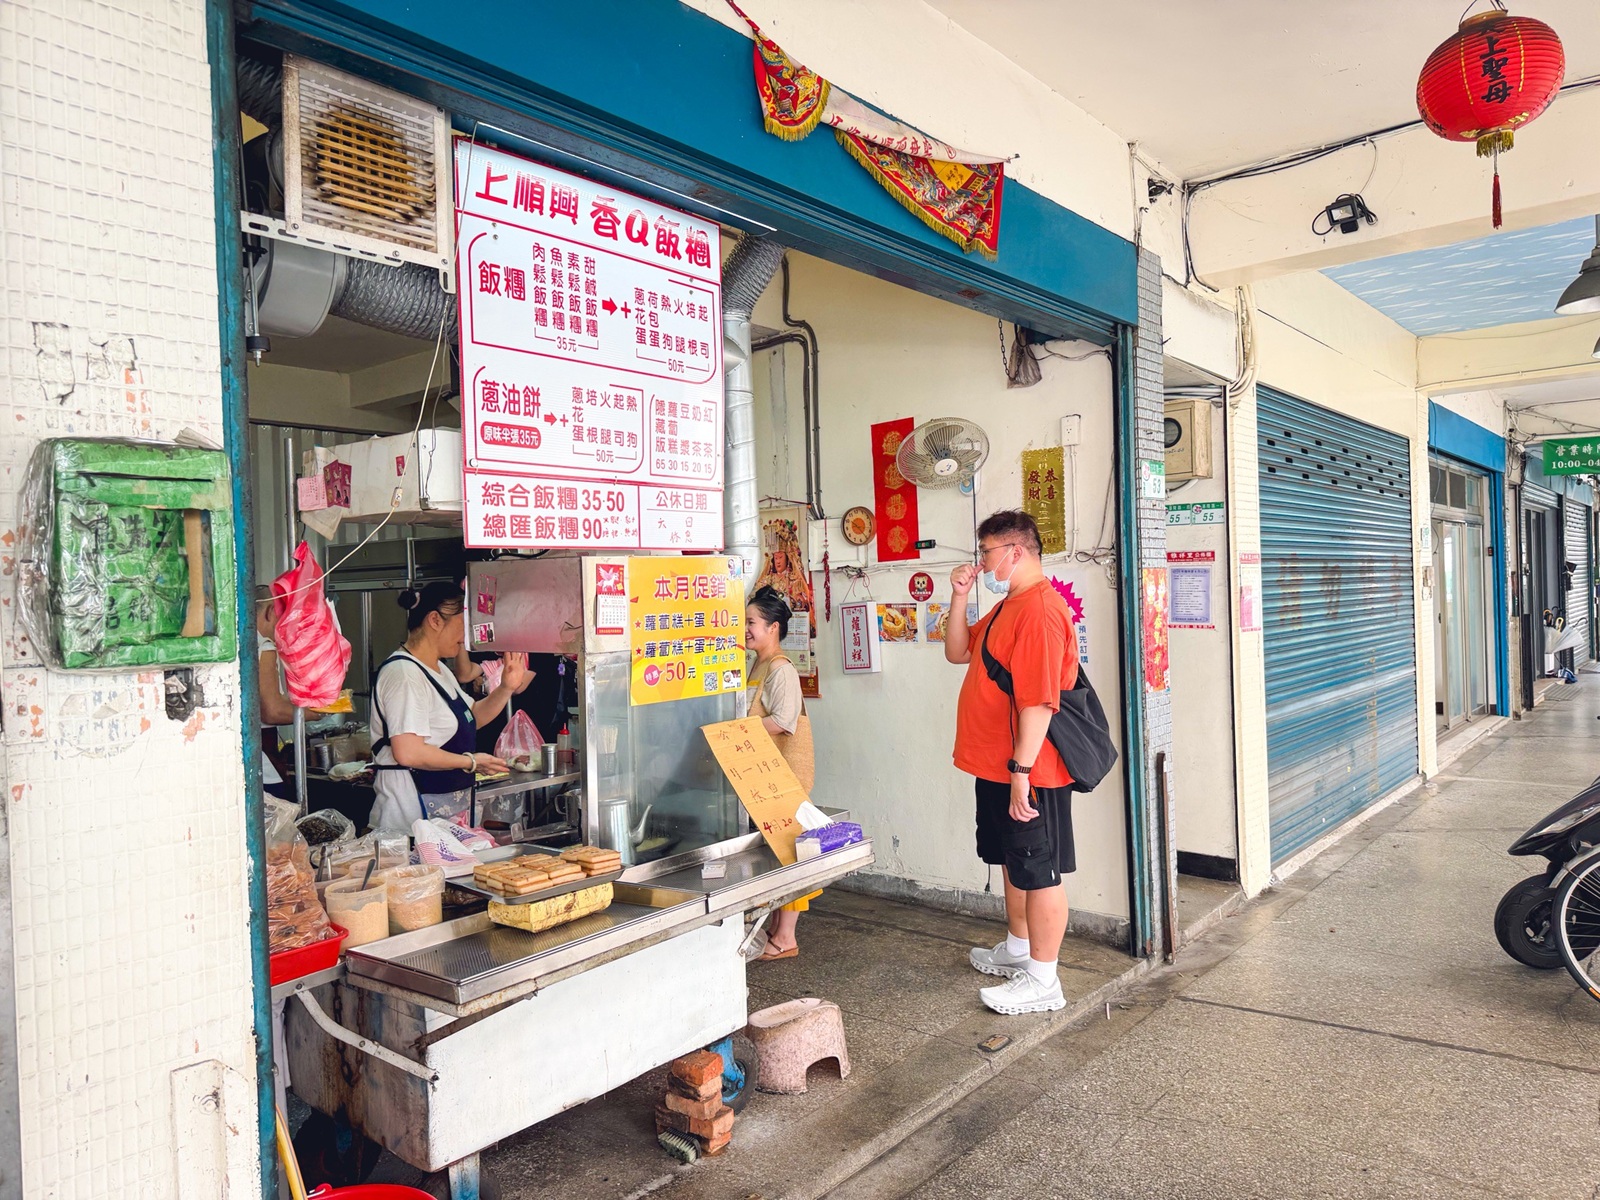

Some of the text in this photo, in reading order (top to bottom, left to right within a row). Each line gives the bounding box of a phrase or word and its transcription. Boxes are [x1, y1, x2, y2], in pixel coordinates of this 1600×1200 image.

[475, 161, 712, 269] 上順興 香Q飯糰
[478, 259, 526, 301] 飯糰
[532, 242, 548, 328] 肉鬆飯糰
[550, 247, 565, 331] 魚鬆飯糰
[567, 252, 582, 335] 素鬆飯糰
[584, 256, 598, 338] 甜鹹飯糰
[648, 291, 660, 349] 荷包蛋
[556, 335, 577, 353] 35元
[668, 358, 685, 374] 50元
[480, 379, 542, 419] 蔥油餅
[596, 449, 614, 464] 50元
[655, 458, 666, 470] 65
[668, 459, 678, 471] 30
[680, 460, 690, 472] 15
[692, 462, 702, 473] 20
[481, 481, 578, 511] 綜合飯糰
[1027, 467, 1059, 501] 恭喜 發財
[656, 490, 708, 511] 公休日期
[482, 513, 602, 540] 總匯飯糰 90
[1169, 514, 1181, 523] 55
[1203, 512, 1214, 522] 55
[654, 574, 728, 601] 本月促銷
[1078, 625, 1089, 664] 預先訂購
